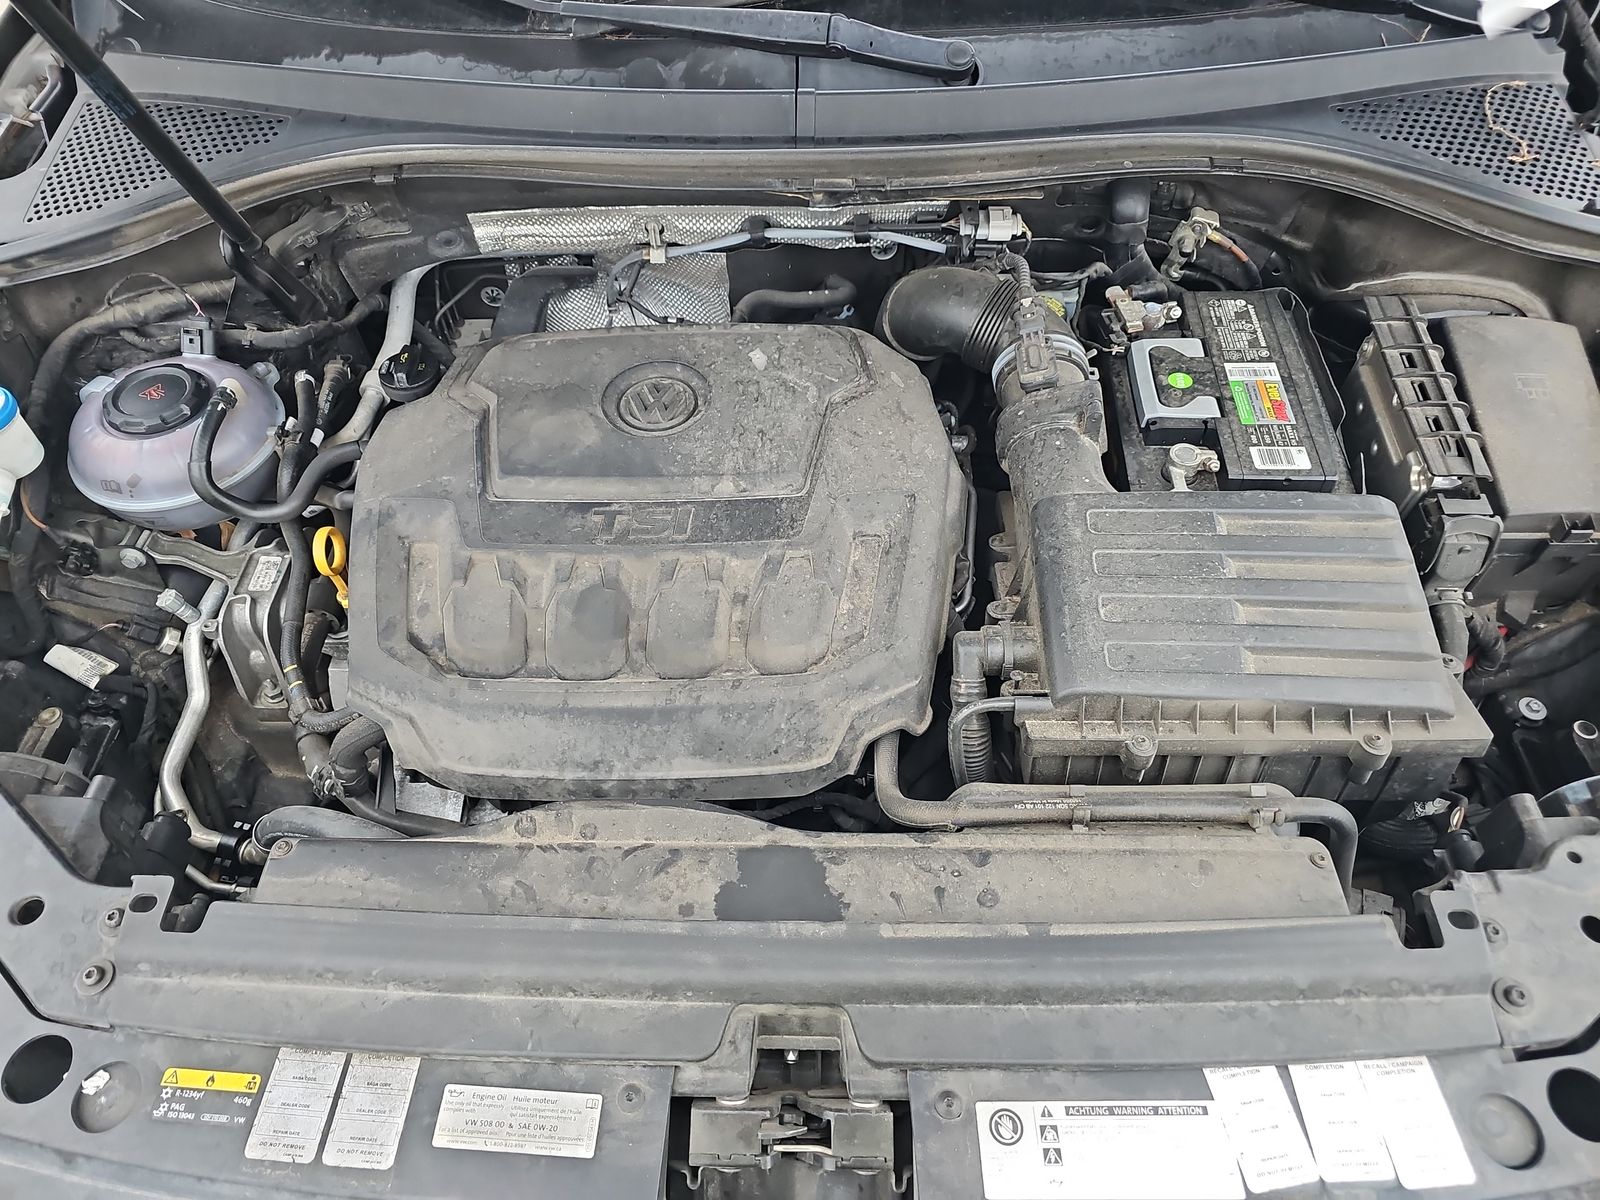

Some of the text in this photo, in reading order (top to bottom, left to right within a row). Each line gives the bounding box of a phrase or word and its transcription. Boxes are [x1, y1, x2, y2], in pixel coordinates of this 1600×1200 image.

[591, 508, 696, 539] TSI
[295, 1048, 332, 1056] COMPLETION
[367, 1054, 405, 1062] COMPLETION
[1304, 1063, 1345, 1071] COMPLETION
[1391, 1060, 1424, 1068] CAMPAIGN
[1376, 1068, 1416, 1076] COMPLETION
[175, 1089, 205, 1101] R-1234yf
[472, 1092, 508, 1101] Engine Oil
[233, 1096, 253, 1107] 460g
[512, 1095, 558, 1105] Huile moteur
[170, 1102, 185, 1111] PAG
[1068, 1106, 1203, 1116] ACHTUNG WARNING ATTENTION
[479, 1119, 493, 1127] 508
[494, 1120, 505, 1128] 00
[518, 1122, 532, 1130] SAE
[533, 1123, 559, 1132] 0W-20
